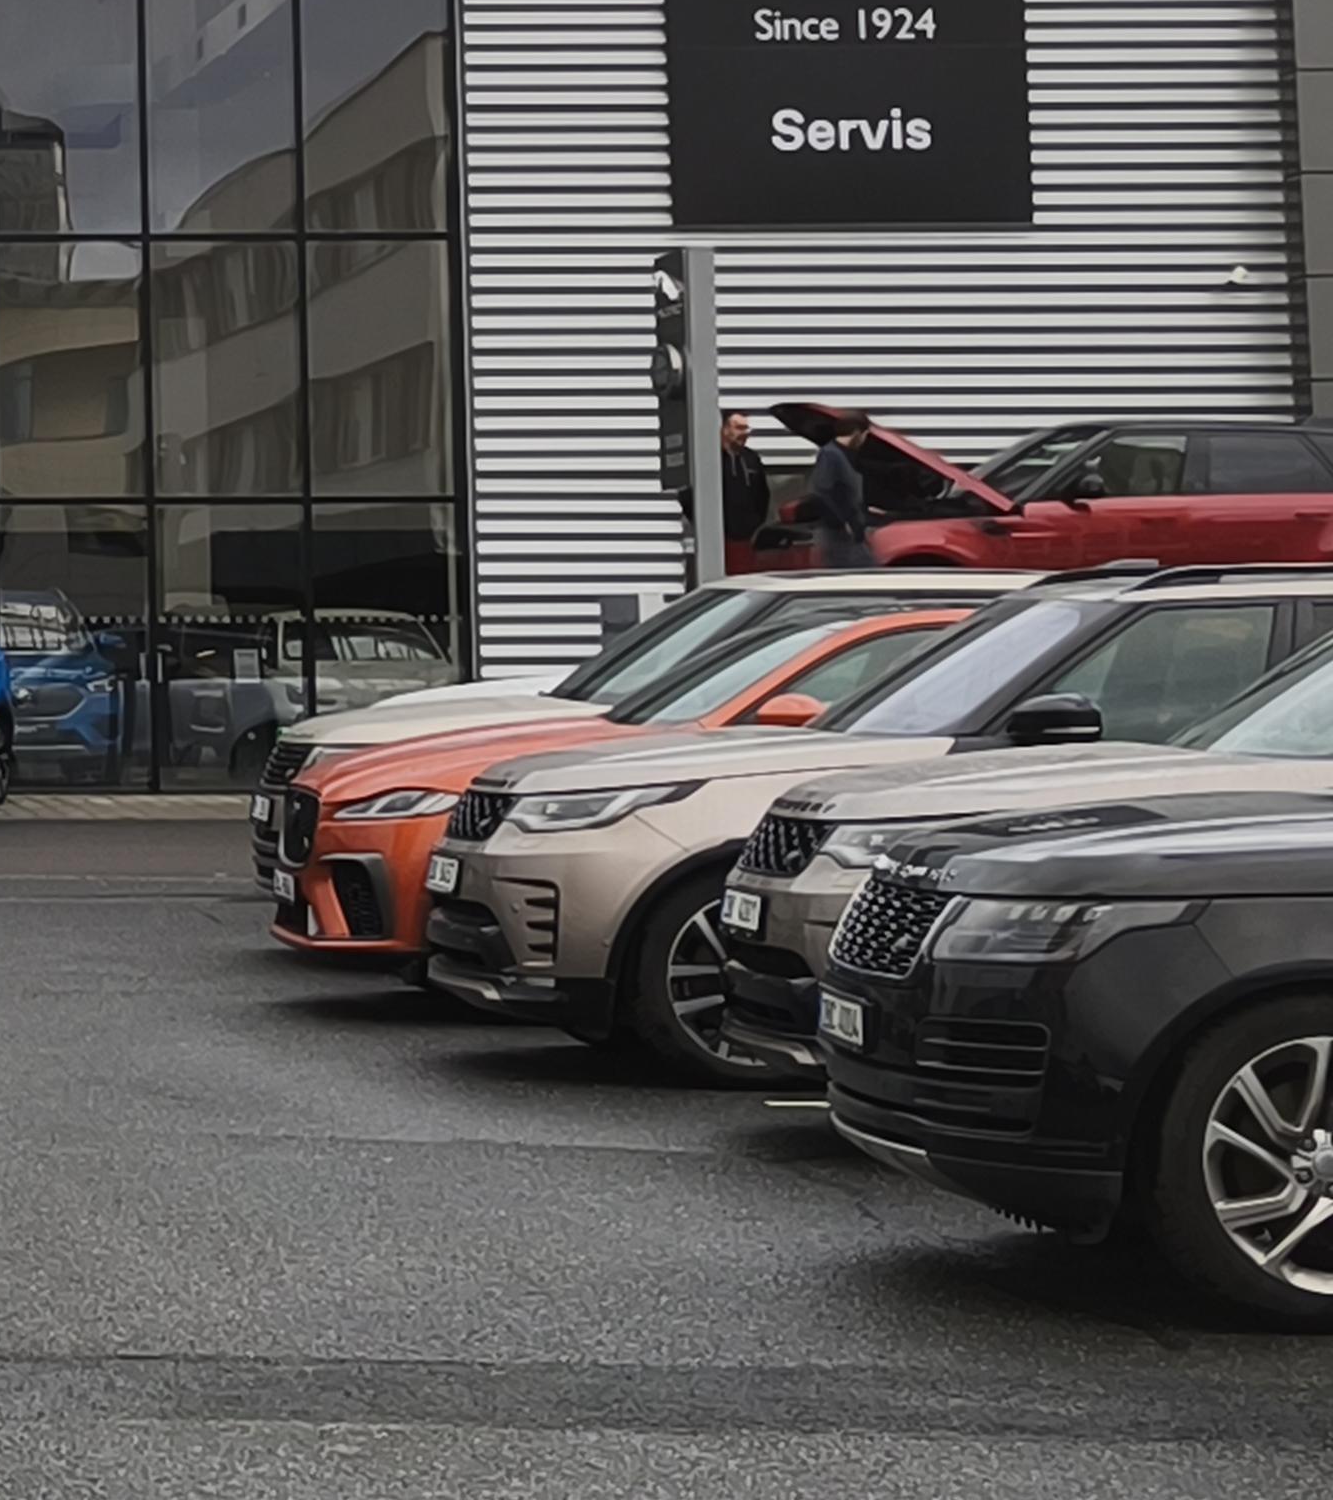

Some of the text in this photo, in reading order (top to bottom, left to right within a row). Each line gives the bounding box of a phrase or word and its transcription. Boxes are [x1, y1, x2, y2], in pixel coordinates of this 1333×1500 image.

[753, 7, 937, 41] Since 1924
[770, 108, 933, 152] Servis
